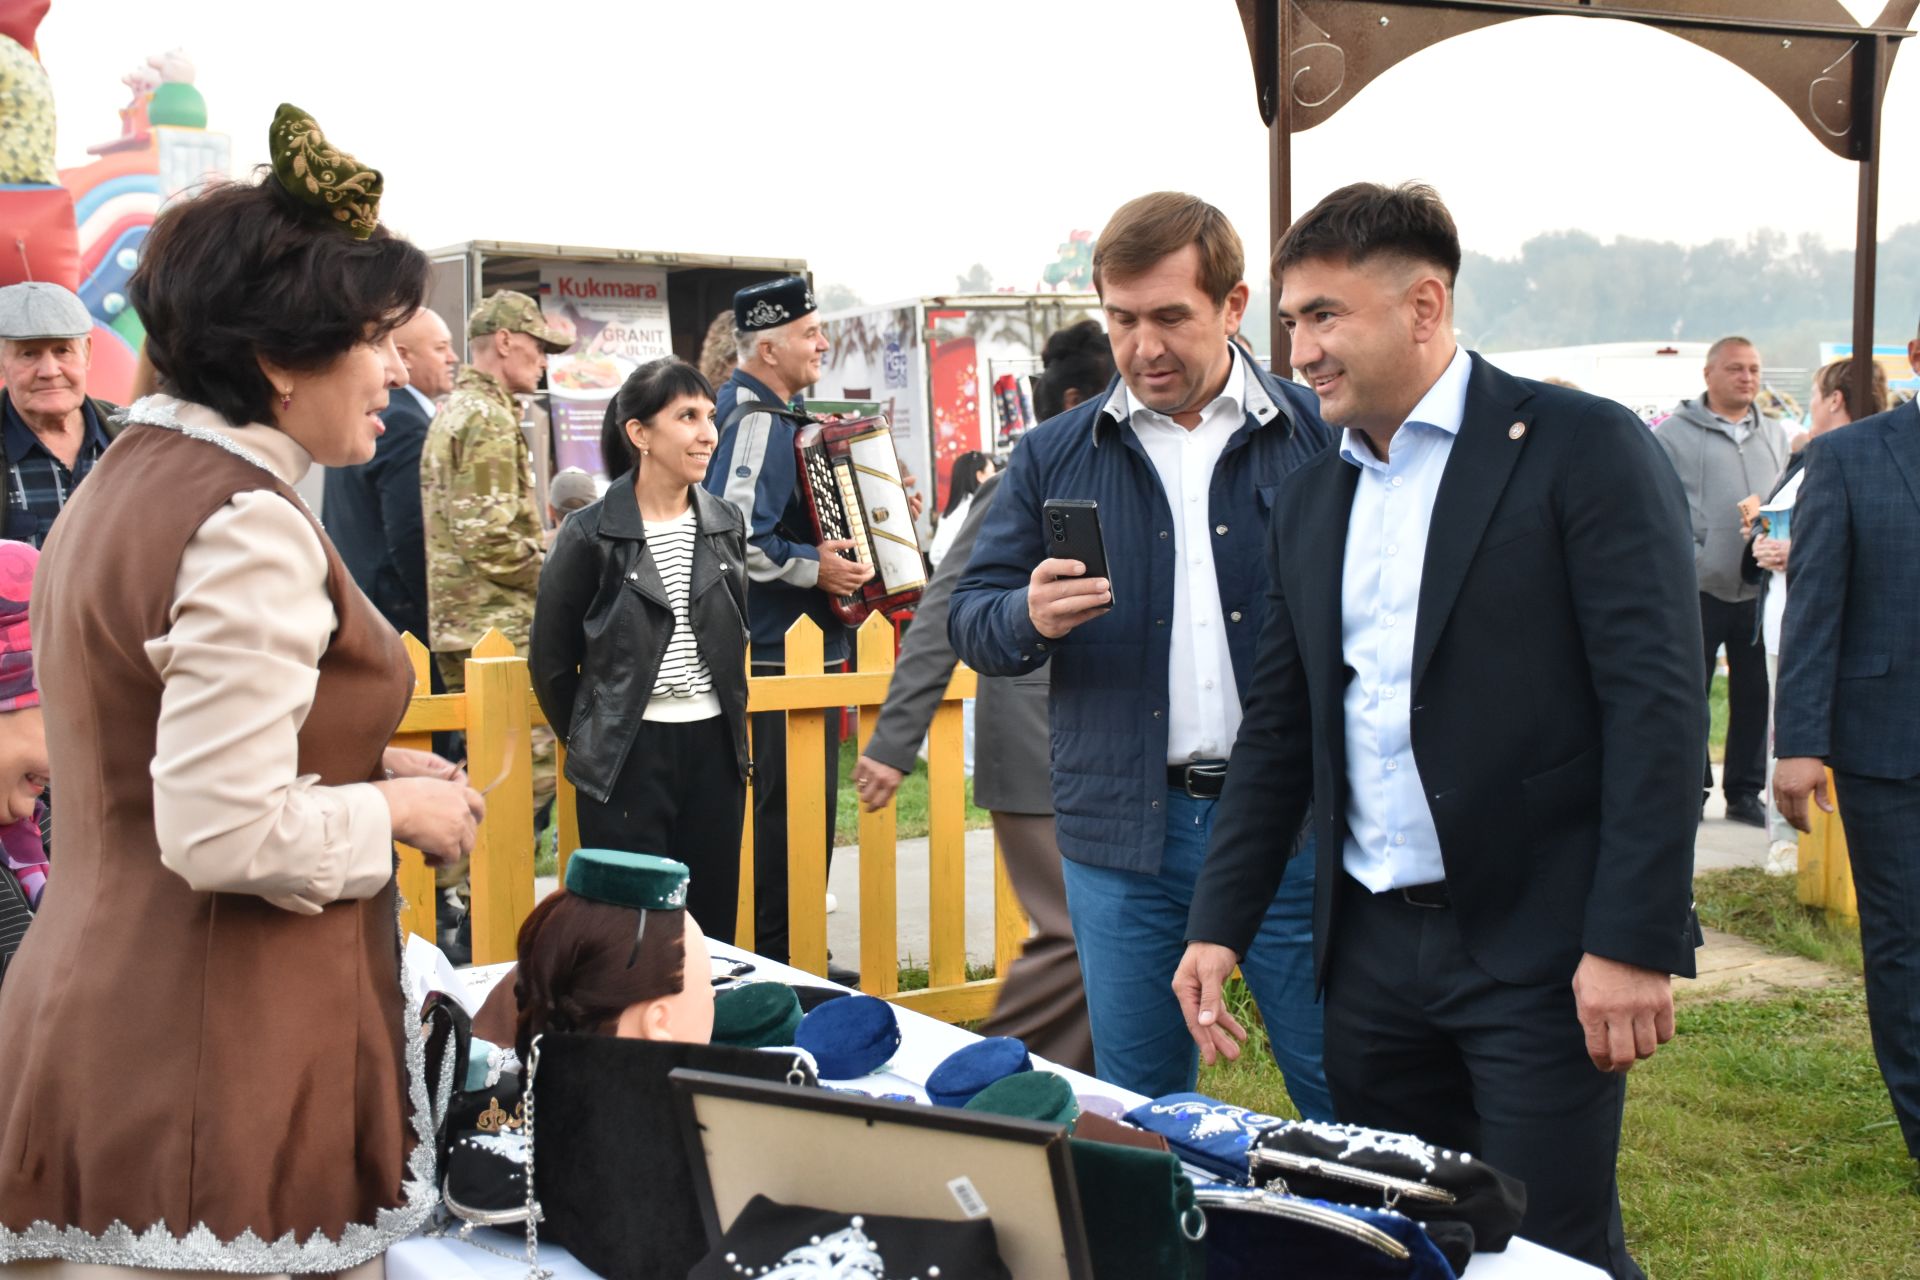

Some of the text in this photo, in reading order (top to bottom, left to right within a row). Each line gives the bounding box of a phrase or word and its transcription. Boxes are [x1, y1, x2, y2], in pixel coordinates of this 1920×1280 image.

[558, 276, 657, 299] Kukmara
[602, 328, 664, 343] GRANIT
[625, 344, 666, 356] ULTRA
